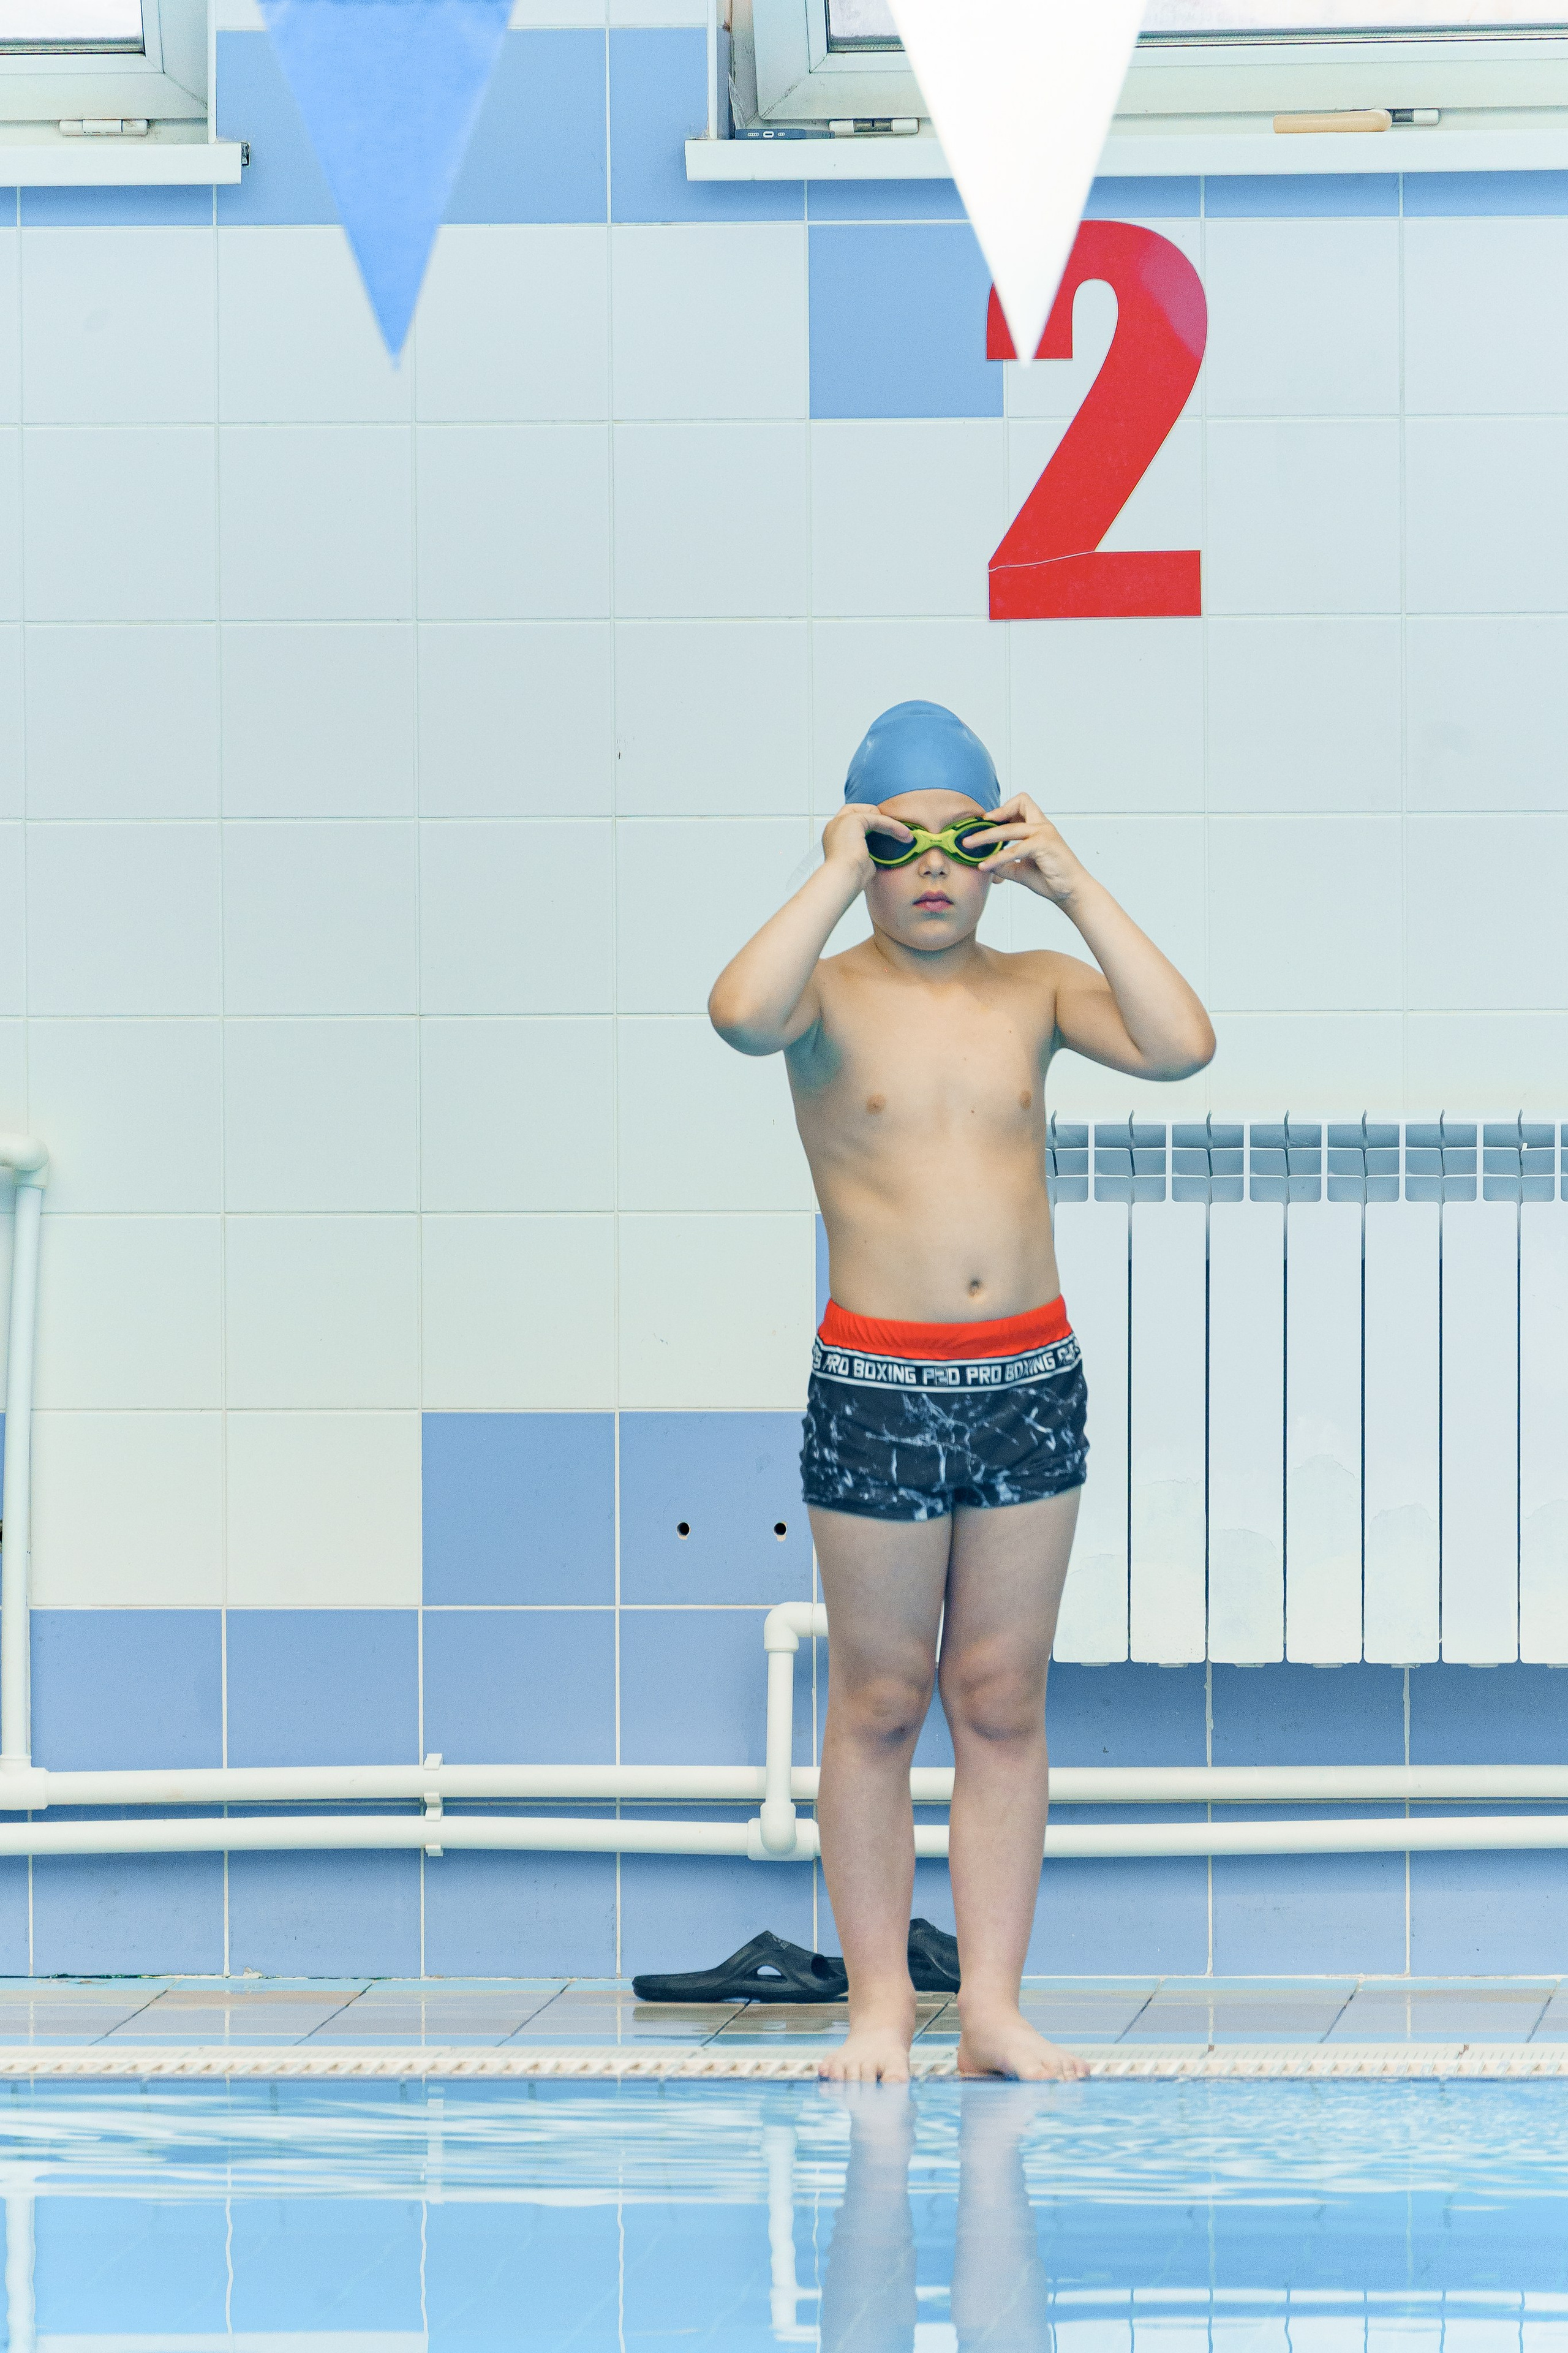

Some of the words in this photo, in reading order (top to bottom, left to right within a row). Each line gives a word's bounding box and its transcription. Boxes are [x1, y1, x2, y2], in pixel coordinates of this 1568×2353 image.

[986, 220, 1208, 621] 2
[853, 1357, 917, 1385] BOXING
[966, 1364, 1002, 1386] PRO
